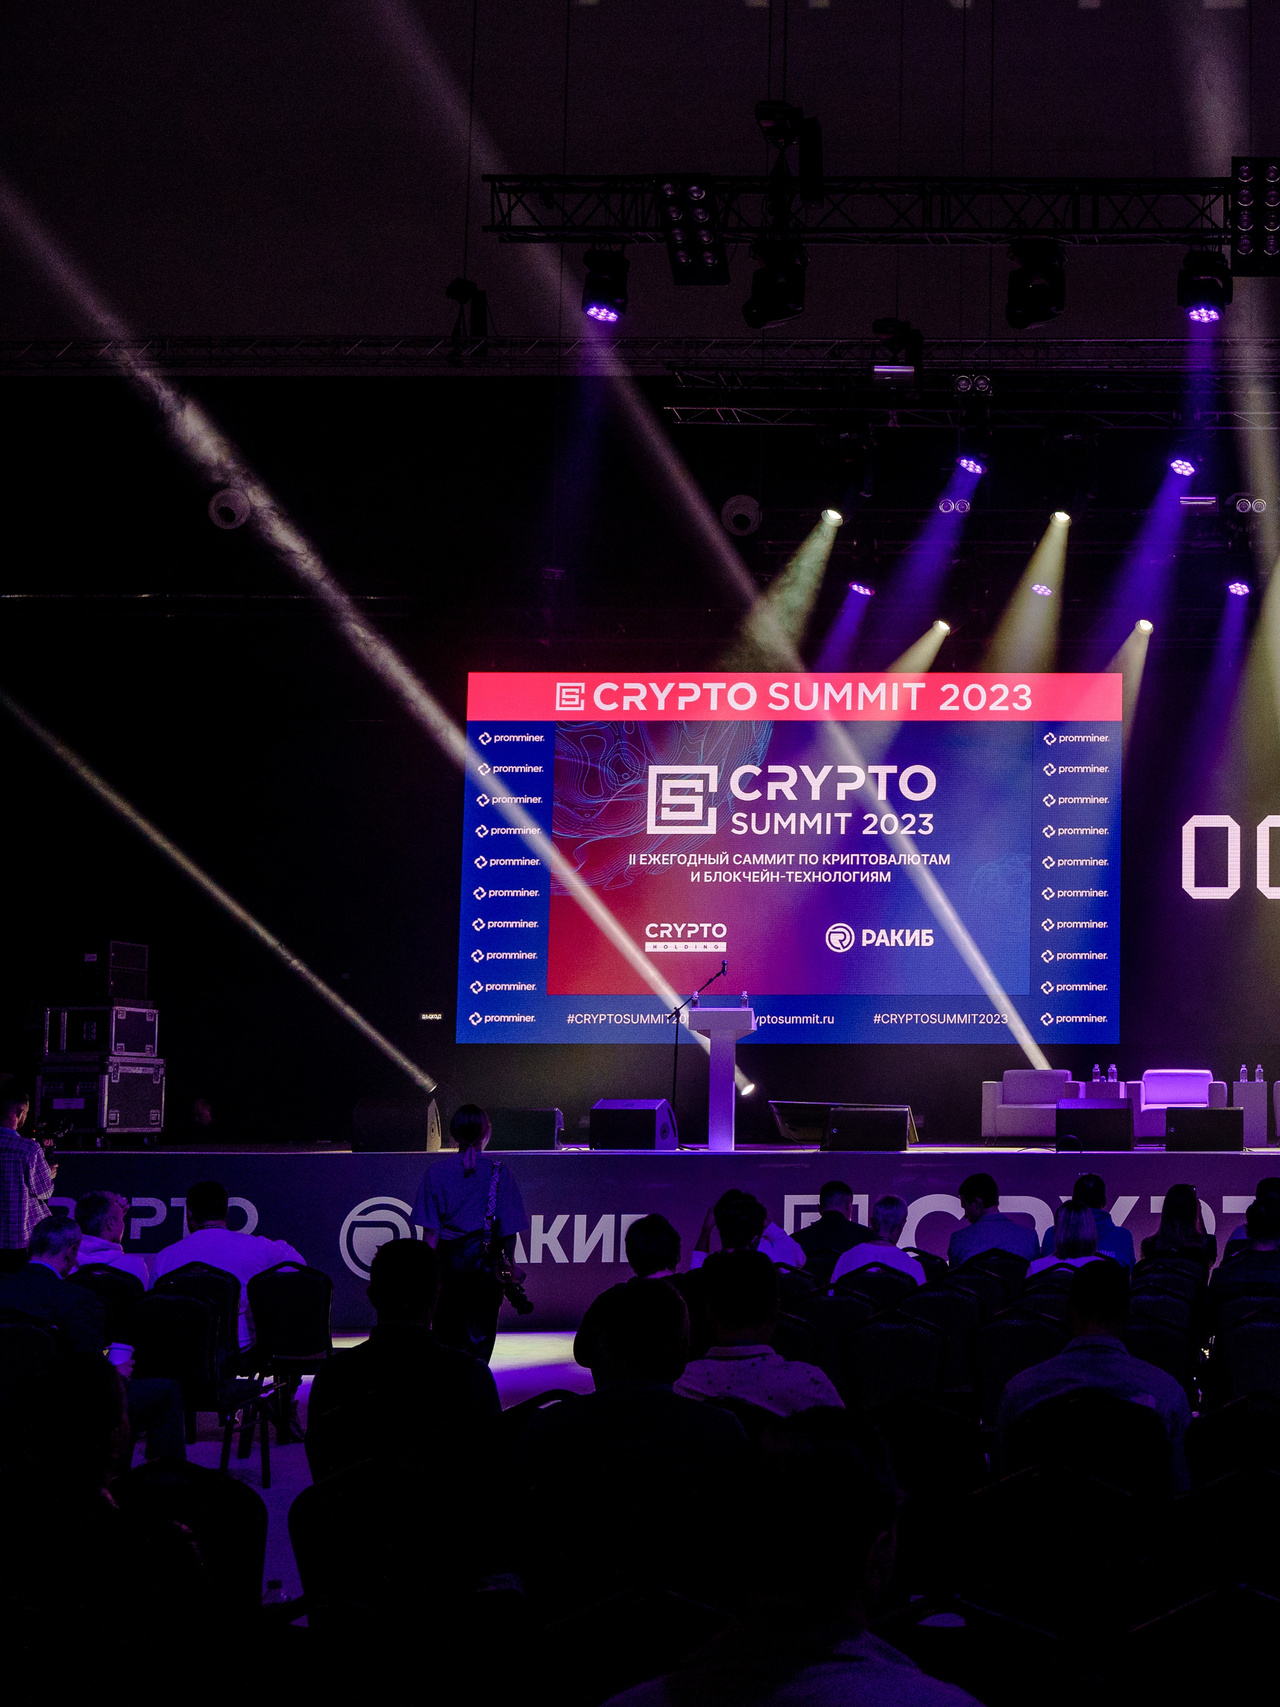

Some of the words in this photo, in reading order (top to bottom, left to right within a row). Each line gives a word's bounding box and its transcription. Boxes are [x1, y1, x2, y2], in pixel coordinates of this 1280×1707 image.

[594, 683, 757, 710] CRYPTO
[768, 682, 925, 710] SUMMIT
[940, 684, 1031, 710] 2023
[730, 765, 936, 801] CRYPTO
[731, 813, 852, 834] SUMMIT
[863, 814, 933, 834] 2023
[640, 852, 729, 867] ЕЖЕГОДНЫЙ
[733, 854, 795, 864] САММИТ
[799, 854, 818, 865] ПО
[823, 854, 950, 865] КРИПТОВАЛЮТАМ
[691, 872, 700, 882] И
[705, 869, 890, 882] БЛОКЧЕЙН-ТЕХНОЛОГИЯМ
[646, 923, 727, 938] CRYPTO
[862, 929, 933, 946] РАКИБ
[567, 1013, 690, 1025] #CRYPTOSUMMIT20
[756, 1014, 834, 1026] yptosummit.ru
[874, 1014, 1007, 1024] #CRYPTOSUMMIT2023
